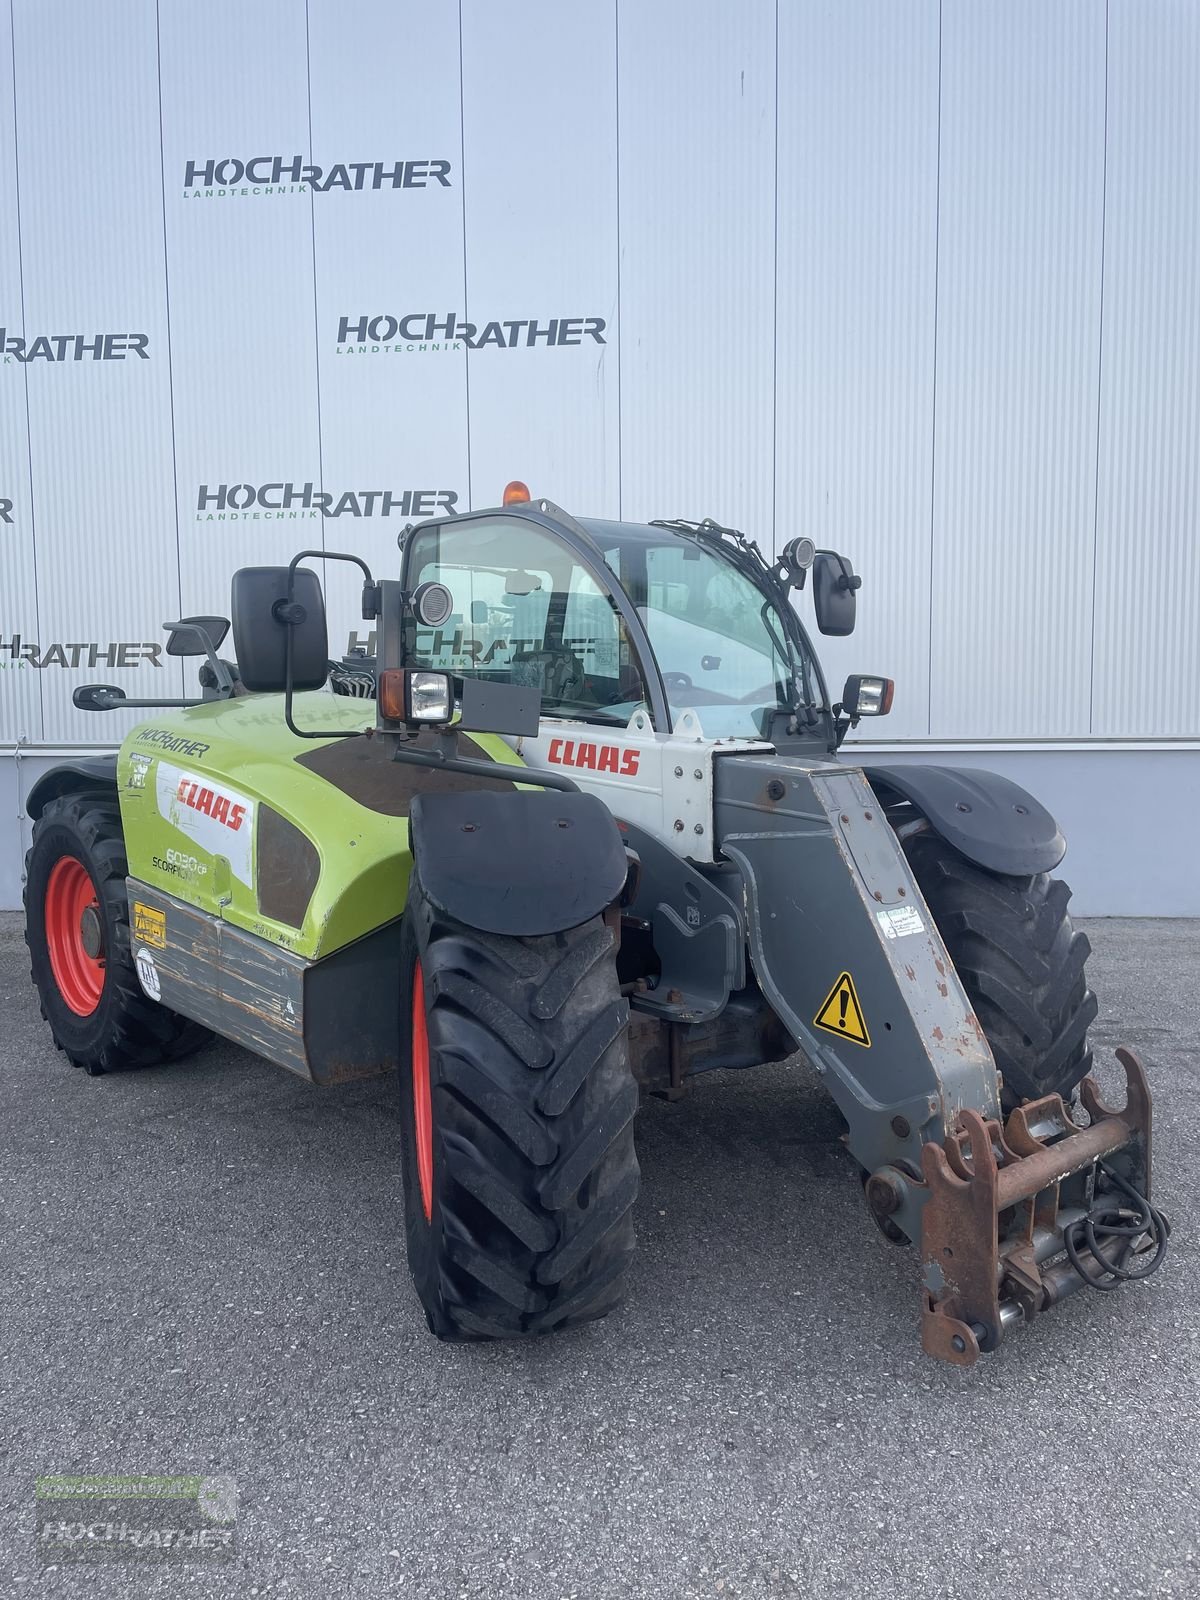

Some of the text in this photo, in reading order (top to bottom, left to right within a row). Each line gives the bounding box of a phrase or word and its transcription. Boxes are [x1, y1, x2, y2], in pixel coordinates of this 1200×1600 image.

[184, 155, 452, 192] HOCHRATHER
[183, 185, 307, 199] LANDTECHNIK
[0, 328, 150, 362] RATHER
[336, 342, 461, 355] LANDTECHNIK
[337, 313, 607, 349] HOCHRATHER
[196, 511, 318, 521] LANDTECHNIK
[197, 482, 459, 518] HOCHRATHER
[548, 739, 641, 776] CLAAS
[177, 779, 247, 831] CLAAS
